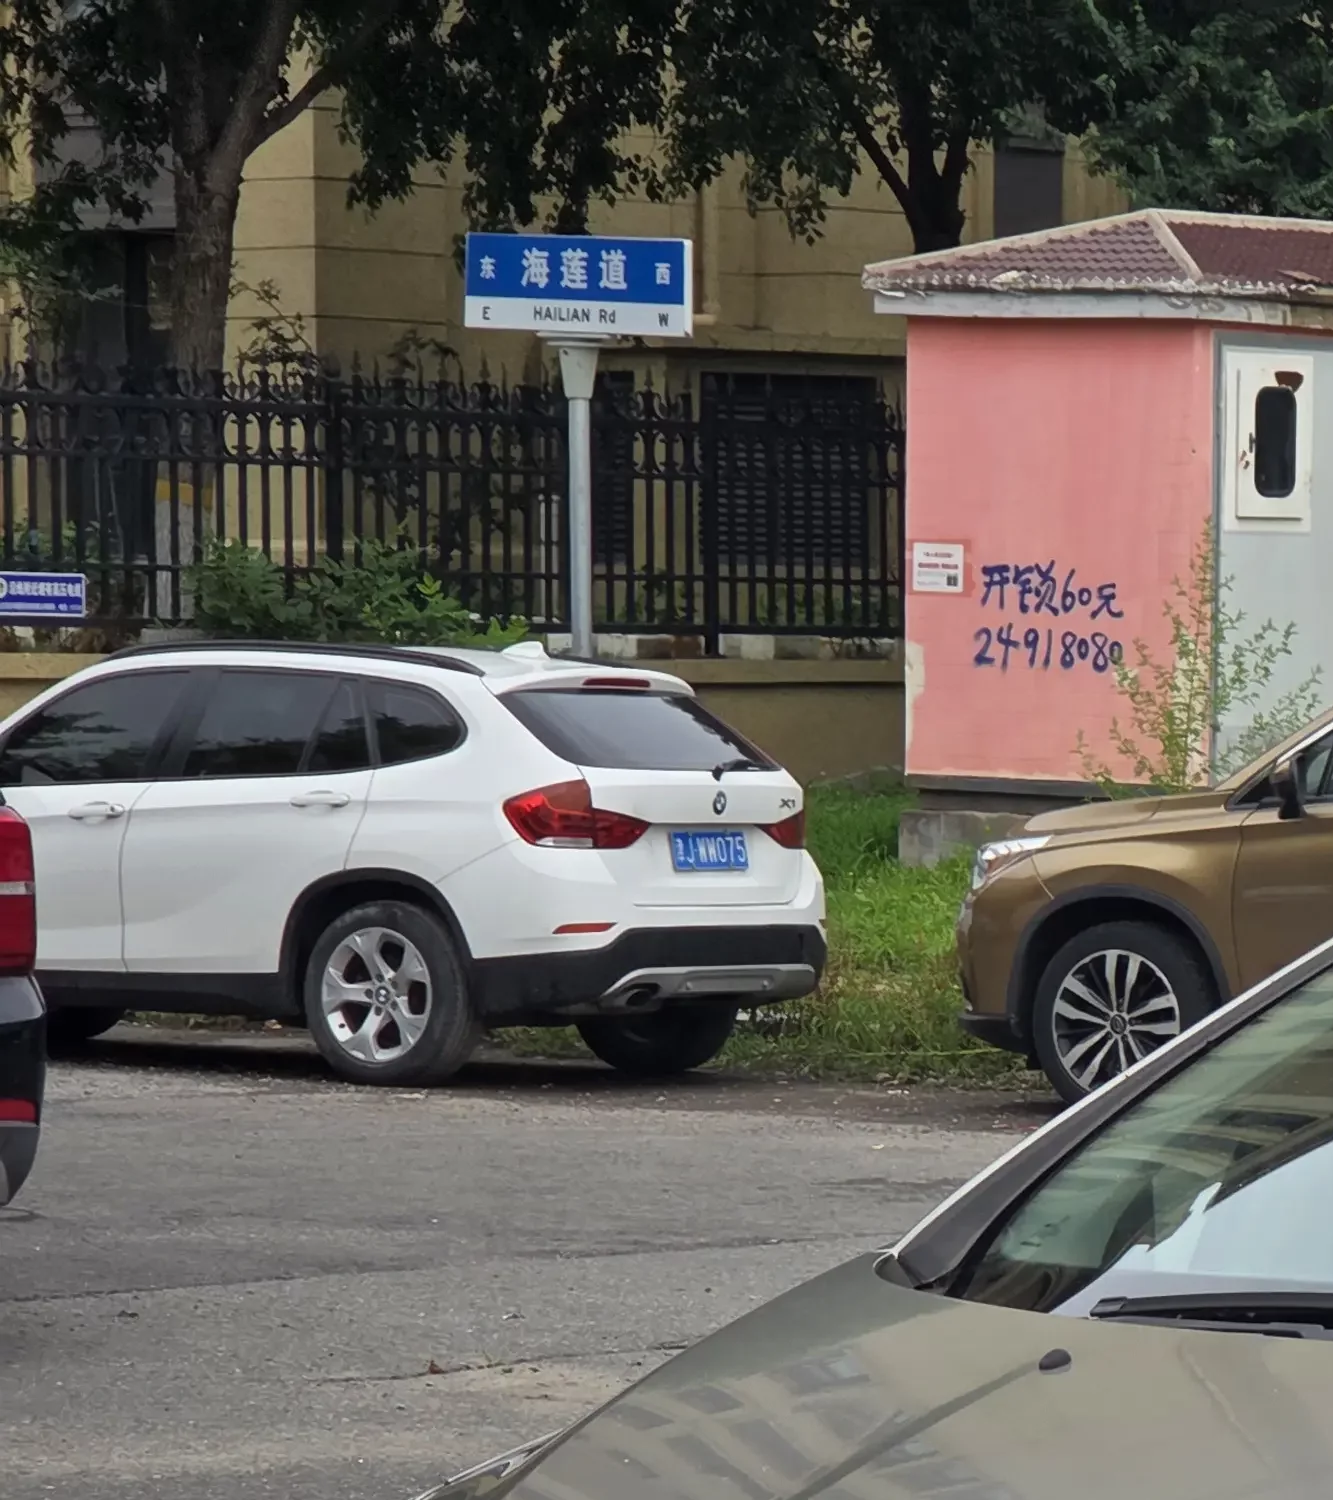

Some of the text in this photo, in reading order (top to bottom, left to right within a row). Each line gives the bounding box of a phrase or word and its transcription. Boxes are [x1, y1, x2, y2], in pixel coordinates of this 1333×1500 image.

[479, 247, 672, 290] 东 海莲道 西
[482, 306, 669, 327] E HAILIAN Rd W
[980, 559, 1125, 620] 开锁60元
[973, 622, 1124, 673] 24918080
[779, 798, 796, 809] X1
